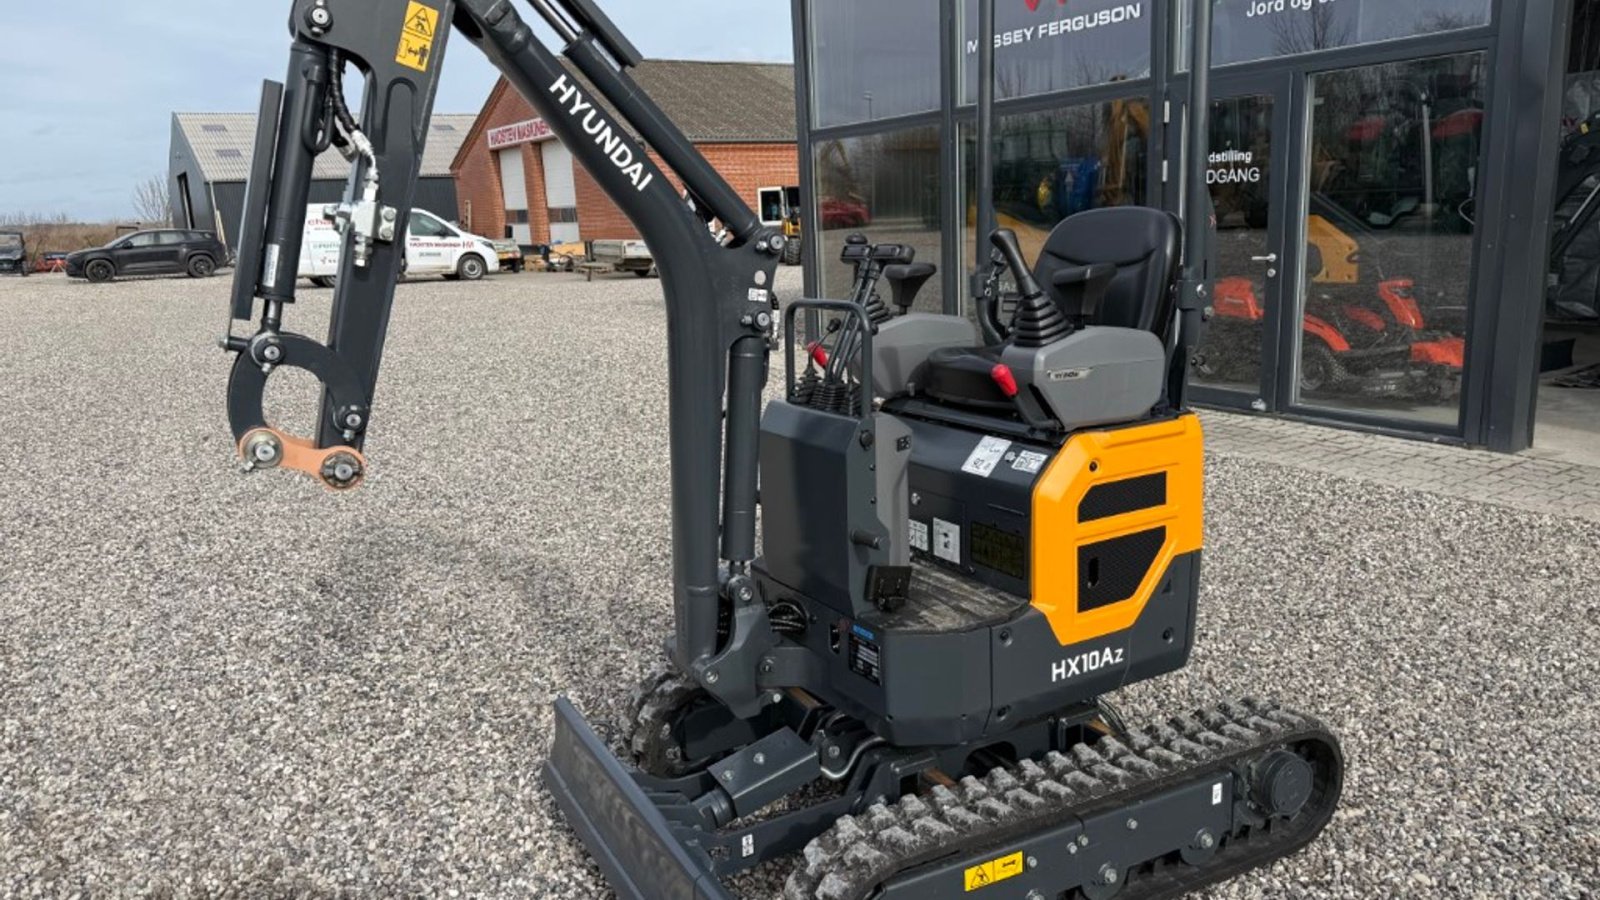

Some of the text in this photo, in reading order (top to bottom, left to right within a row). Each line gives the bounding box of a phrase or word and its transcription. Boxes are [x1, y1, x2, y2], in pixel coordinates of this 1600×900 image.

[967, 3, 1141, 54] MSSEY FERGUSON
[548, 74, 653, 192] HYUNDAI
[1208, 151, 1252, 164] dstilling
[1206, 167, 1261, 184] DGANG
